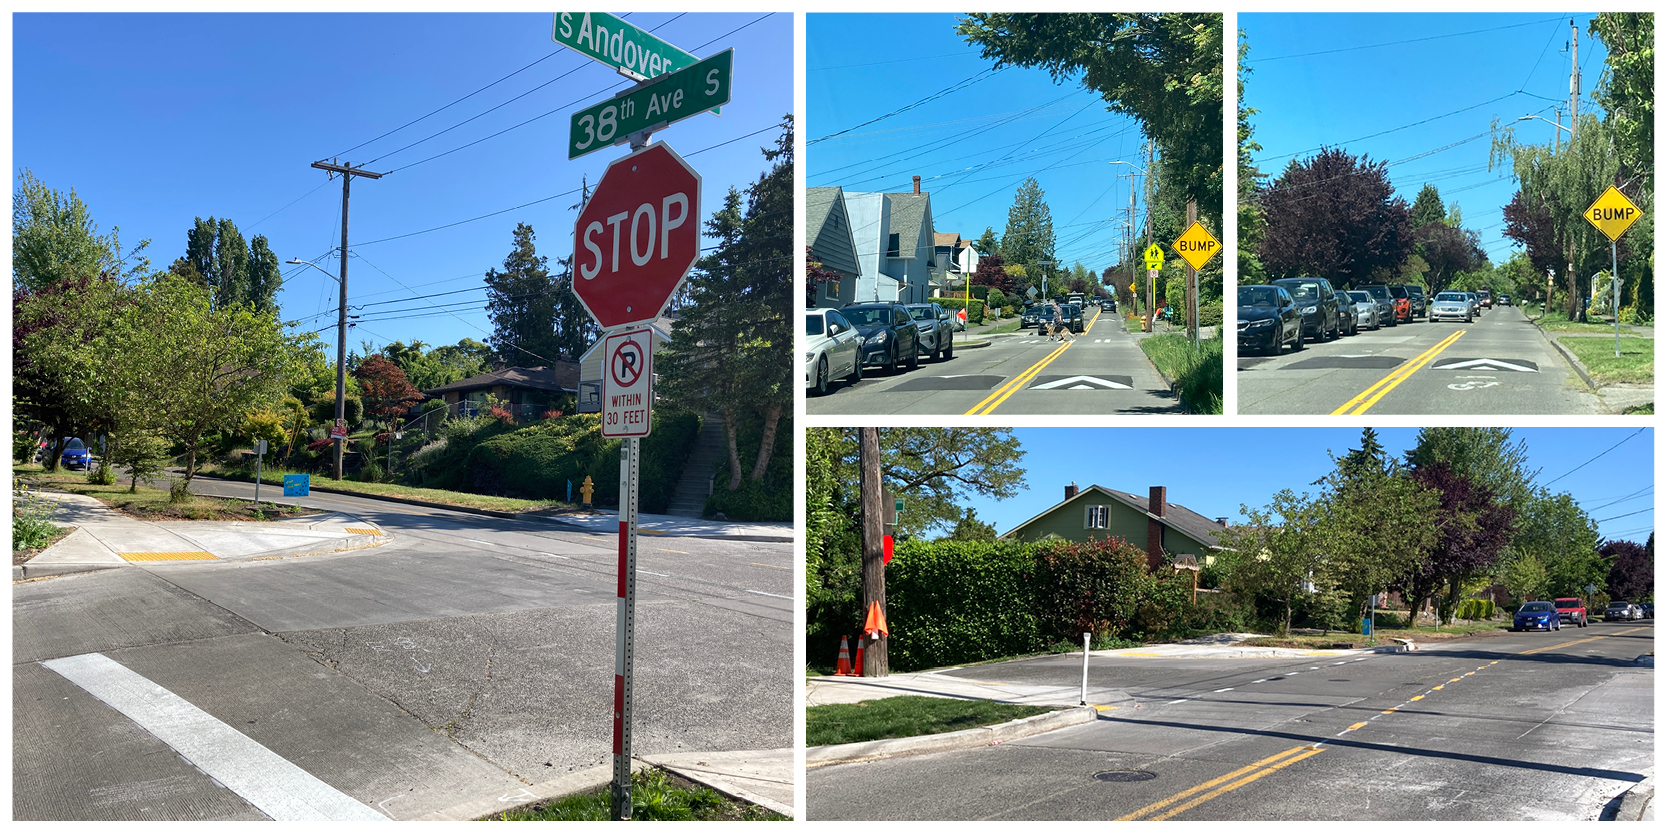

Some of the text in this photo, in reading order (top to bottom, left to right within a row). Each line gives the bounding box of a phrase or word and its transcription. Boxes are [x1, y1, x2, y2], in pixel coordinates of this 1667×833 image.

[559, 12, 673, 79] S Andover
[575, 68, 720, 150] 38th Ave S
[1593, 207, 1635, 221] BUMP
[580, 192, 689, 280] STOP
[1180, 240, 1216, 252] BUMP
[612, 393, 642, 408] WITHIN
[606, 409, 645, 425] 30 FEET
